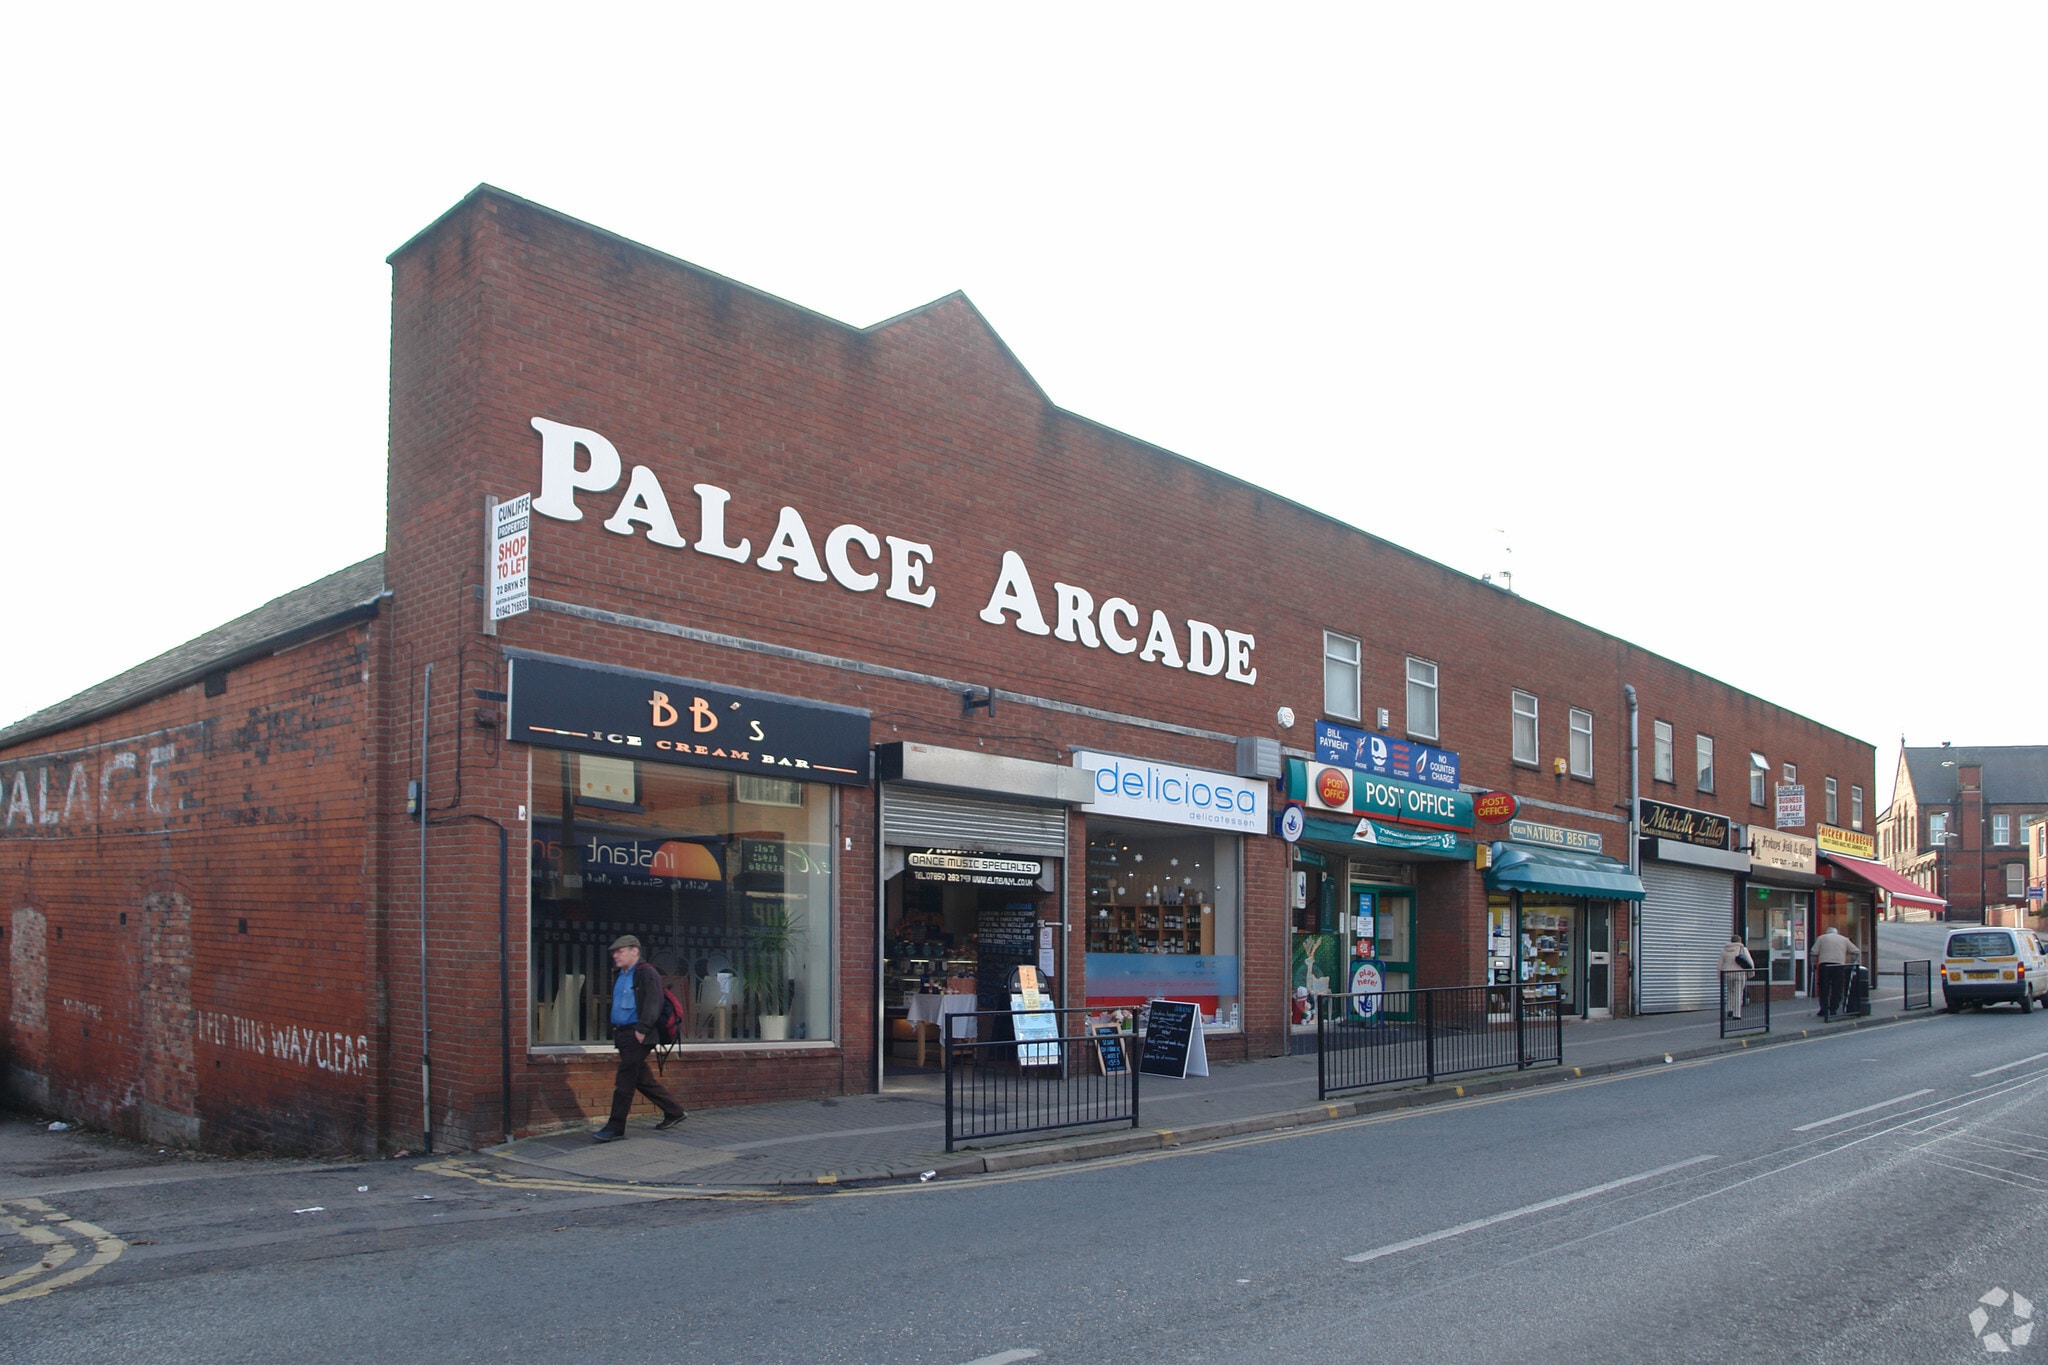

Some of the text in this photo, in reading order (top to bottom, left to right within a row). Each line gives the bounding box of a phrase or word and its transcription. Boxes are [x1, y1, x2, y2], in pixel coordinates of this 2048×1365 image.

[498, 496, 529, 522] CUNLIFFE
[498, 517, 529, 538] PROPERTIES
[498, 535, 527, 562] SHOP
[530, 416, 1257, 686] PALACE ARCADE
[497, 555, 527, 580] TO LET
[496, 577, 527, 595] 72 BRYN ST
[1327, 728, 1341, 740] BILL
[592, 730, 810, 769] ICE CREAM BAR
[1319, 737, 1349, 751] PAYMENT
[1438, 754, 1447, 764] NO
[1429, 762, 1456, 775] COUNTER
[0, 743, 175, 827] ALACE
[1326, 778, 1344, 789] POST
[1431, 772, 1455, 784] CHARGE
[1096, 761, 1256, 814] deliciosa
[1323, 788, 1346, 800] OFFICE
[1365, 781, 1455, 817] POST OFFICE
[1481, 796, 1506, 807] POST
[1779, 796, 1803, 804] BUSINESS
[1477, 805, 1510, 817] OFFICE
[1779, 804, 1789, 812] FOR
[1189, 811, 1255, 827] delicatessen
[1640, 805, 1695, 834] Michelle
[1566, 831, 1588, 847] BEST
[1844, 832, 1873, 847] BARBECUE
[912, 855, 1038, 873] DANCE MUSIC SPECIALIST
[1359, 968, 1377, 978] play
[1357, 979, 1378, 987] here!
[232, 1015, 266, 1056] THIS
[270, 1022, 314, 1068] WAY
[315, 1031, 369, 1077] CLEAR
